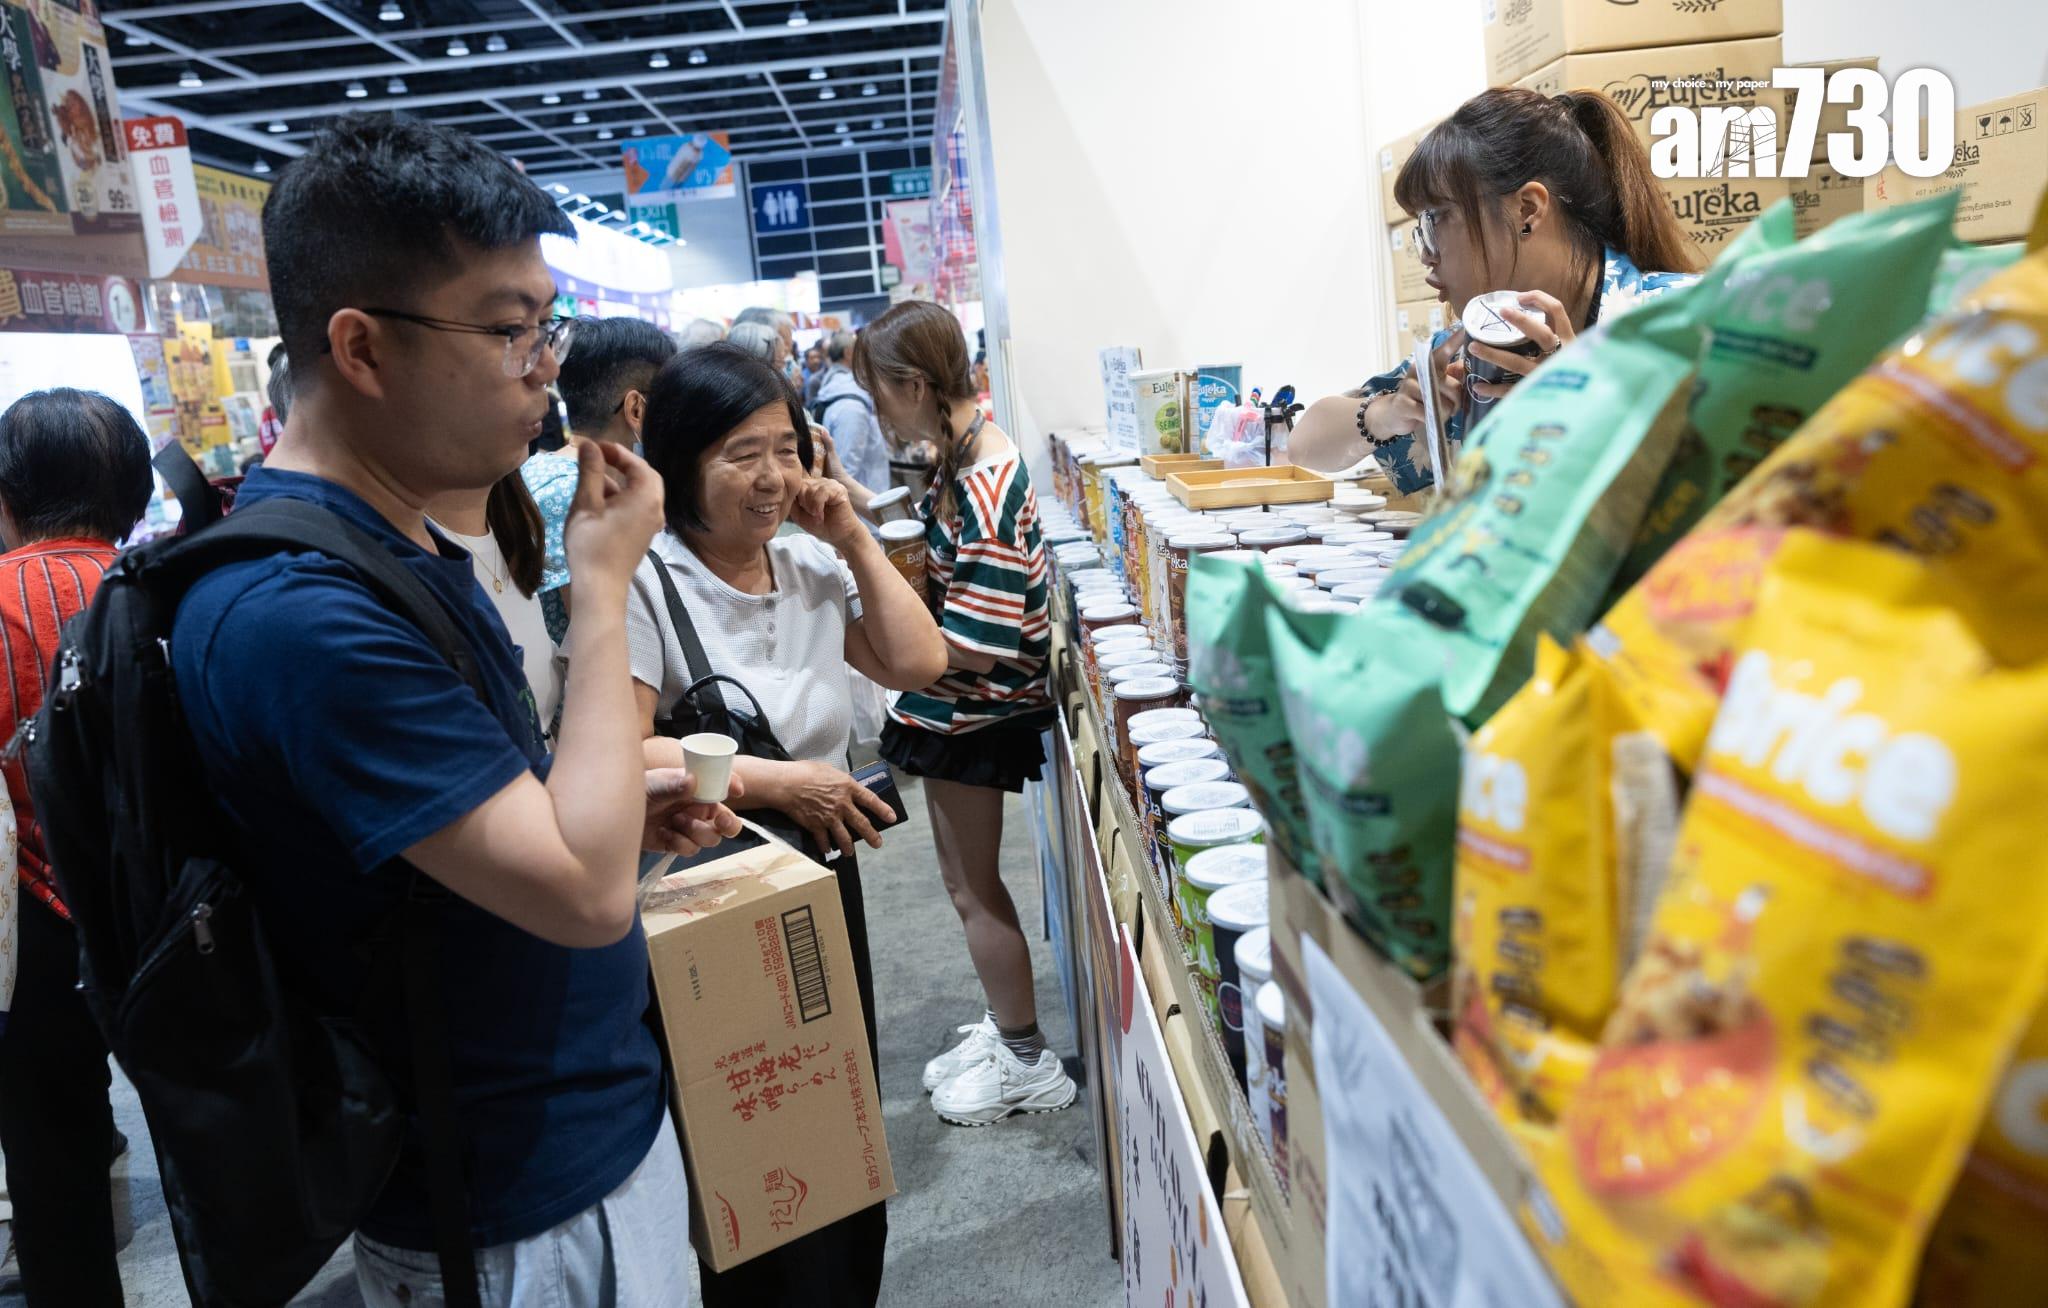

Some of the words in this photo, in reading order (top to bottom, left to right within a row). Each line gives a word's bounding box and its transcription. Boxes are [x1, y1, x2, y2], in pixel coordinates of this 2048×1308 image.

[1650, 67, 1757, 108] Eureka
[132, 123, 176, 150] 免費
[1951, 140, 1980, 164] eka
[726, 1041, 832, 1095] 甘海老だし
